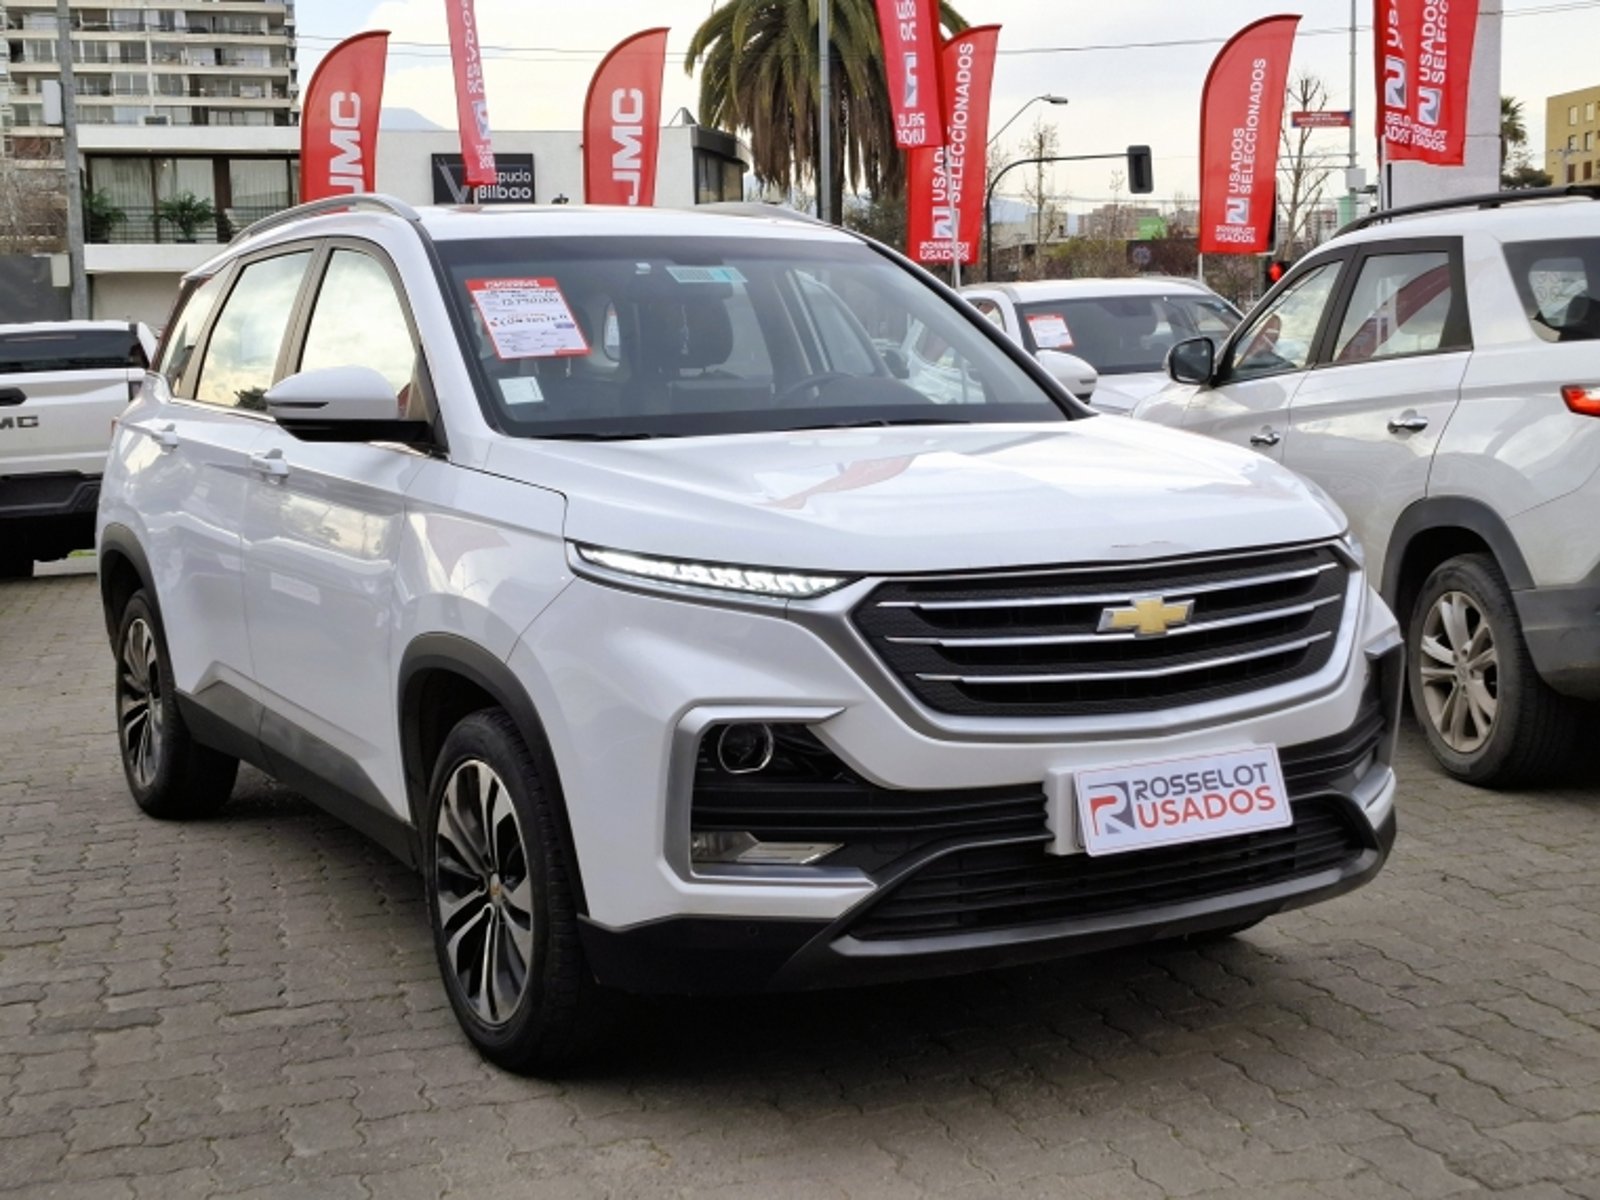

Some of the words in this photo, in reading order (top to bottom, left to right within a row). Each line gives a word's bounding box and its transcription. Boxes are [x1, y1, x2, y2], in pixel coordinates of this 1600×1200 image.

[329, 91, 365, 195] JMC
[611, 87, 644, 205] JMC
[948, 42, 974, 204] SELECCIONADOS
[1229, 128, 1245, 193] USADOS
[1240, 58, 1267, 194] SELECCIONADOS
[479, 185, 533, 200] Bilbao
[1132, 762, 1268, 802] ROSSELOT
[1136, 785, 1277, 829] USADOS
